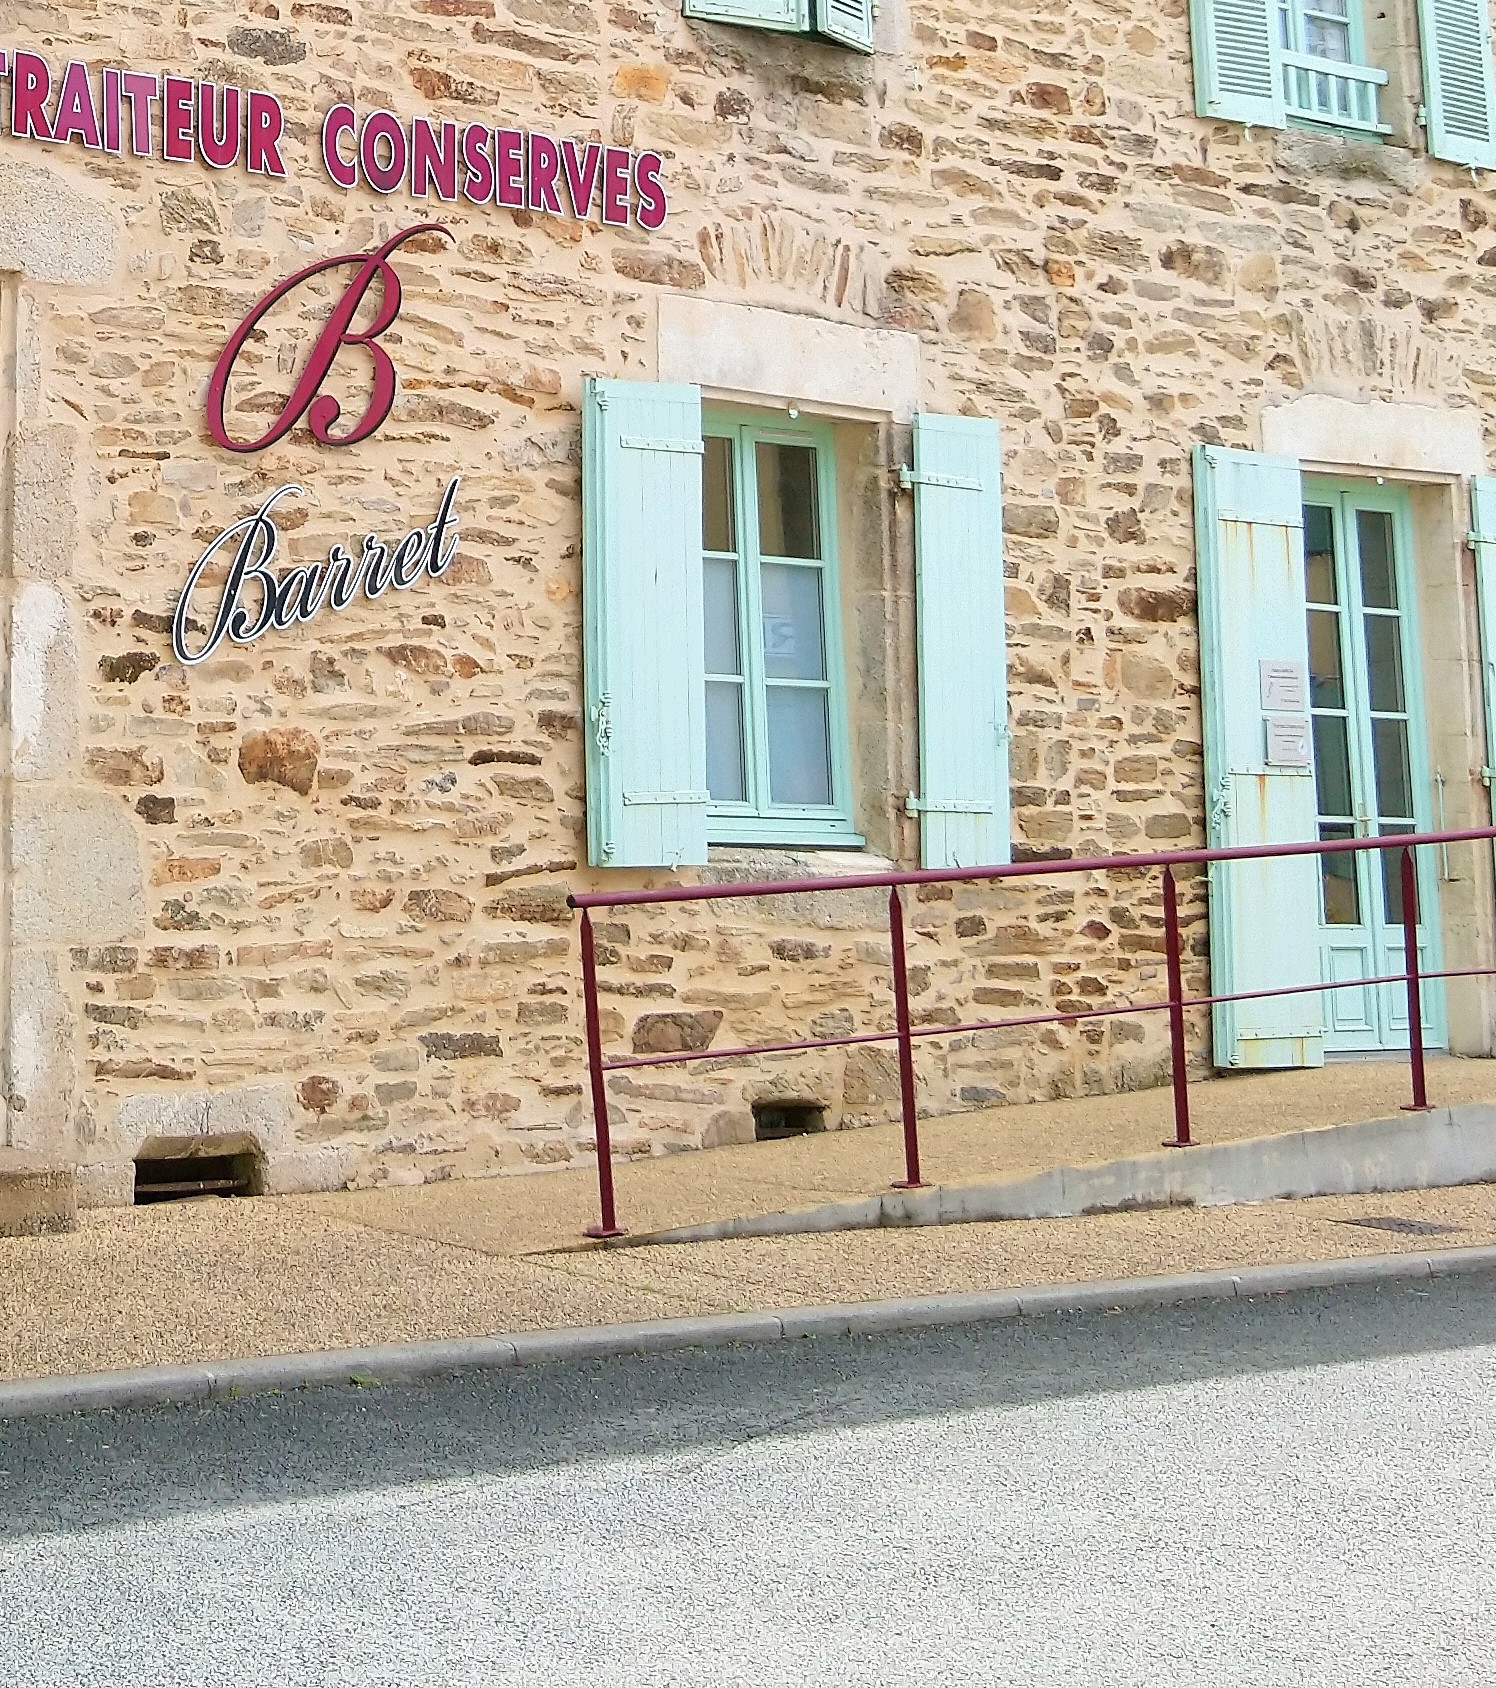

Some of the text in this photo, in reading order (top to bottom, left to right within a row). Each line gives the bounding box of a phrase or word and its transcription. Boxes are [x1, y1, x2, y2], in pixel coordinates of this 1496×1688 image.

[320, 103, 668, 232] CONSERVES
[206, 222, 456, 454] B
[171, 474, 461, 666] Barret
